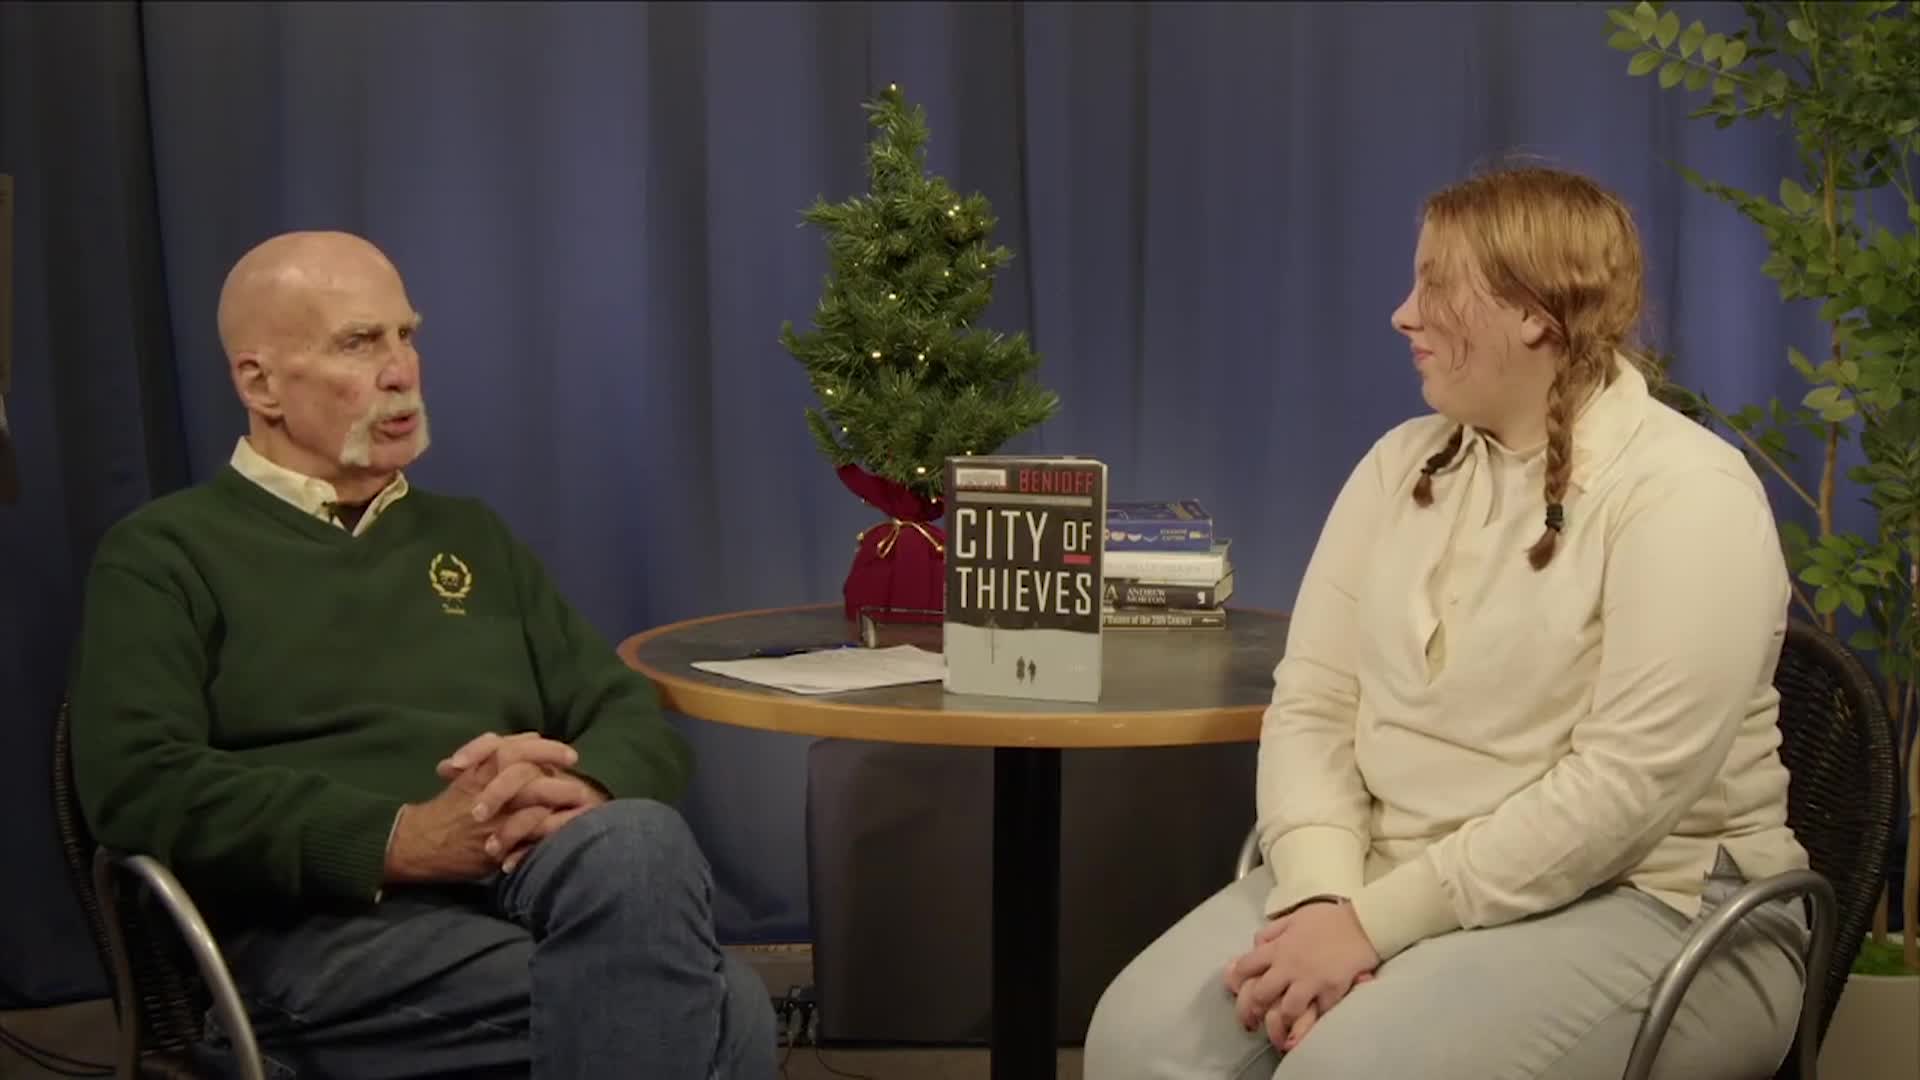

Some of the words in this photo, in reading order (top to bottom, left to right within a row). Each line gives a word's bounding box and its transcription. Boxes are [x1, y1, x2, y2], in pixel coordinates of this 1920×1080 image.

[1019, 470, 1095, 493] BENIOFF
[956, 508, 1048, 562] CITY
[1063, 521, 1092, 551] OF
[956, 567, 1091, 615] THIEVES
[1127, 587, 1165, 596] ANDREW
[1127, 595, 1166, 604] MORTON
